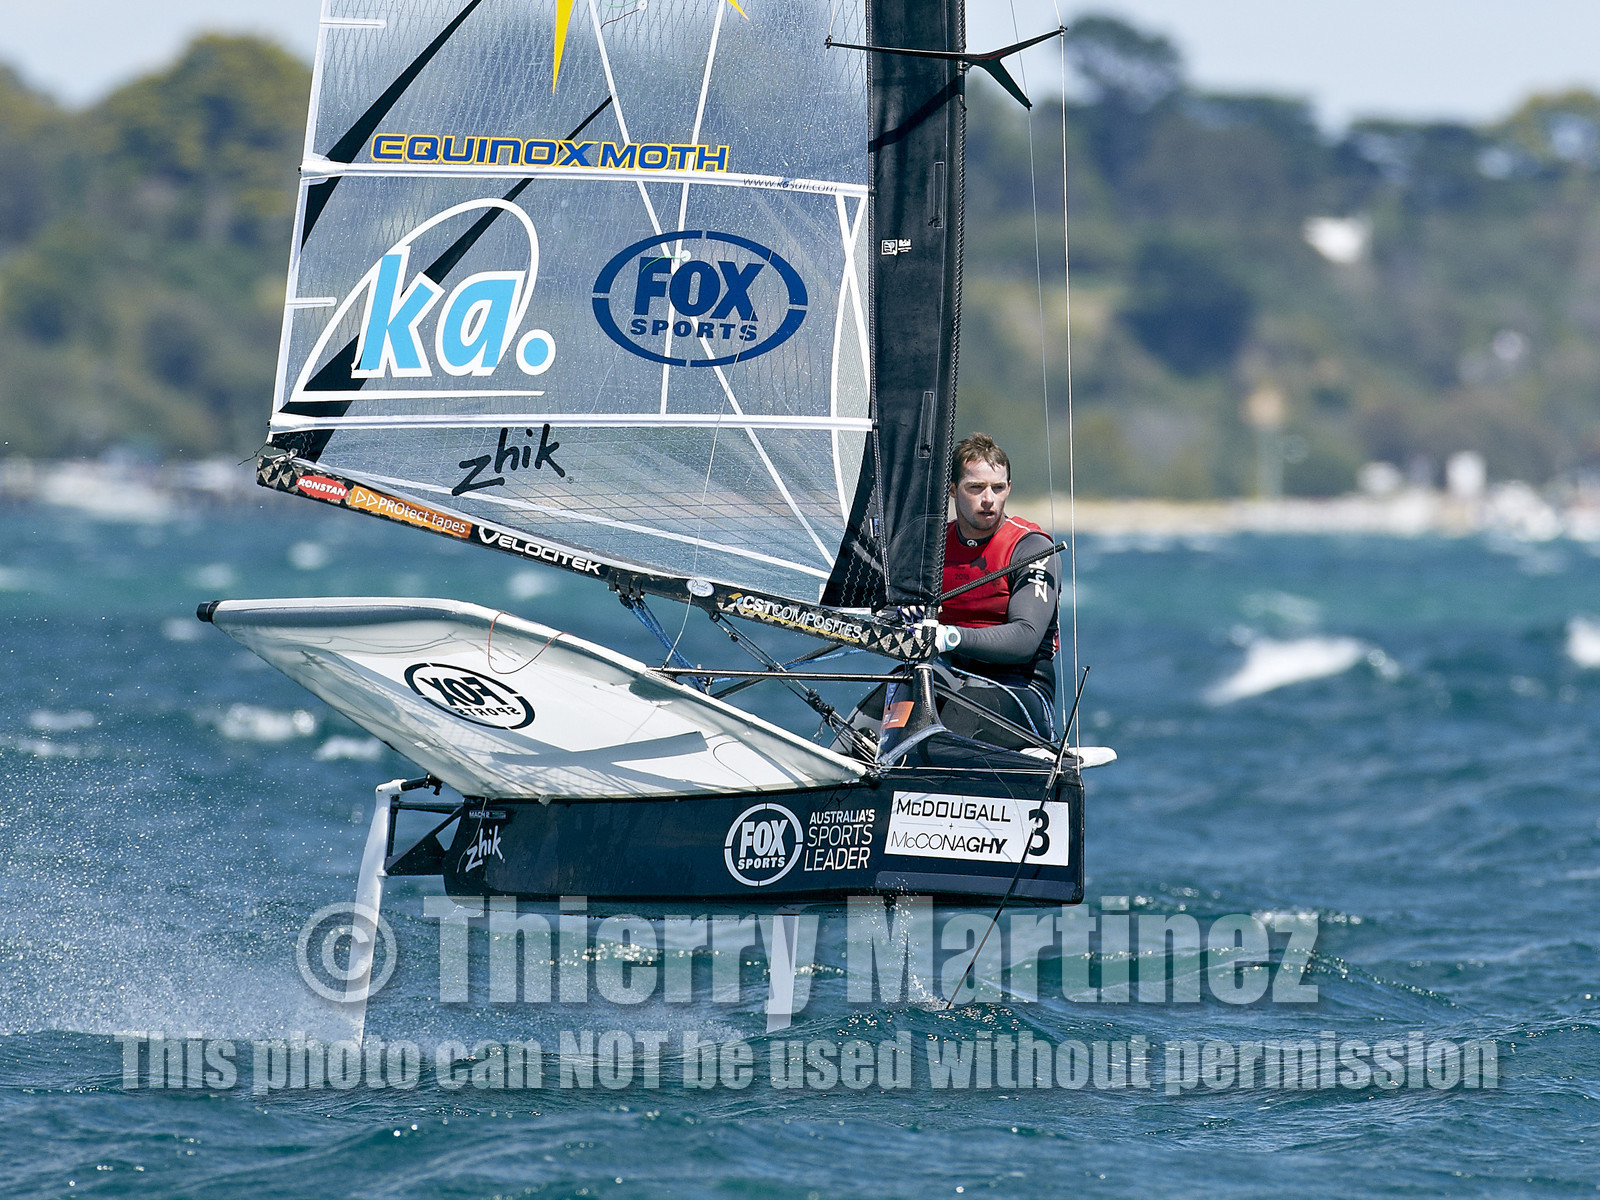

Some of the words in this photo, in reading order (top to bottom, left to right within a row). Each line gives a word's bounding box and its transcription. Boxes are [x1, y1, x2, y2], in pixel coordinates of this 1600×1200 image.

[371, 133, 598, 168] EQUINOX
[598, 141, 730, 172] MOTH
[633, 256, 765, 321] FOX
[630, 318, 758, 341] SPORTS
[452, 423, 566, 496] zhik
[298, 478, 347, 498] RONSTAN
[378, 497, 430, 523] PROtect
[431, 513, 467, 534] tapes
[478, 525, 602, 575] VELOCITEK
[1027, 555, 1051, 603] zhik
[807, 823, 874, 847] SPORTS
[809, 808, 876, 825] AUSTRALIA'S
[1027, 808, 1051, 856] 3
[465, 825, 503, 873] zhik
[739, 819, 789, 858] FOX
[891, 830, 1009, 855] McCONAGHY
[737, 856, 786, 870] SPORTS
[804, 846, 871, 871] LEADER
